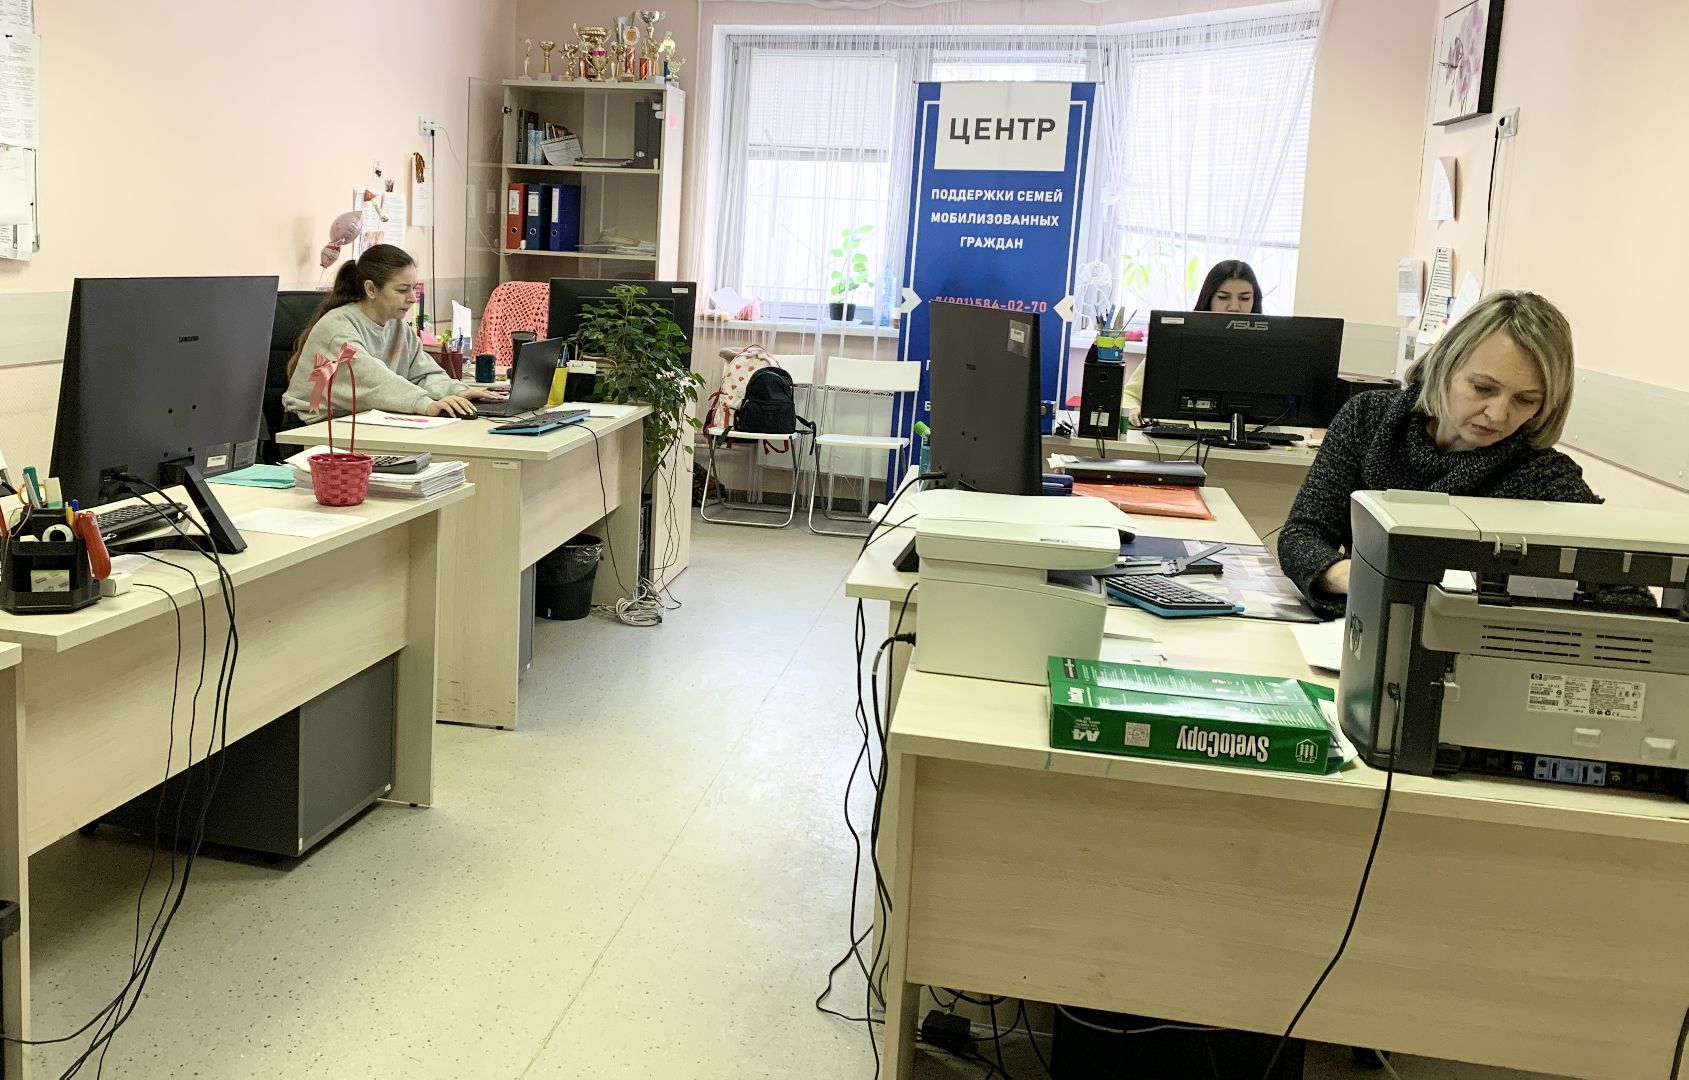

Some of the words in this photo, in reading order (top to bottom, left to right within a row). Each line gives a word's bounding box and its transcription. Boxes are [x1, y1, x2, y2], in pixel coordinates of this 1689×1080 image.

[949, 117, 1056, 145] ЦЕНТР
[931, 188, 1014, 202] ПОДДЕРЖКИ
[1017, 188, 1063, 202] СЕМЕЙ
[930, 211, 1060, 227] МОБИЛИЗОВАННЫХ
[960, 236, 1024, 250] ГРАЖДАН
[1225, 320, 1269, 331] ASUS
[1072, 728, 1101, 743] A4
[1176, 725, 1270, 763] SvetoCopy
